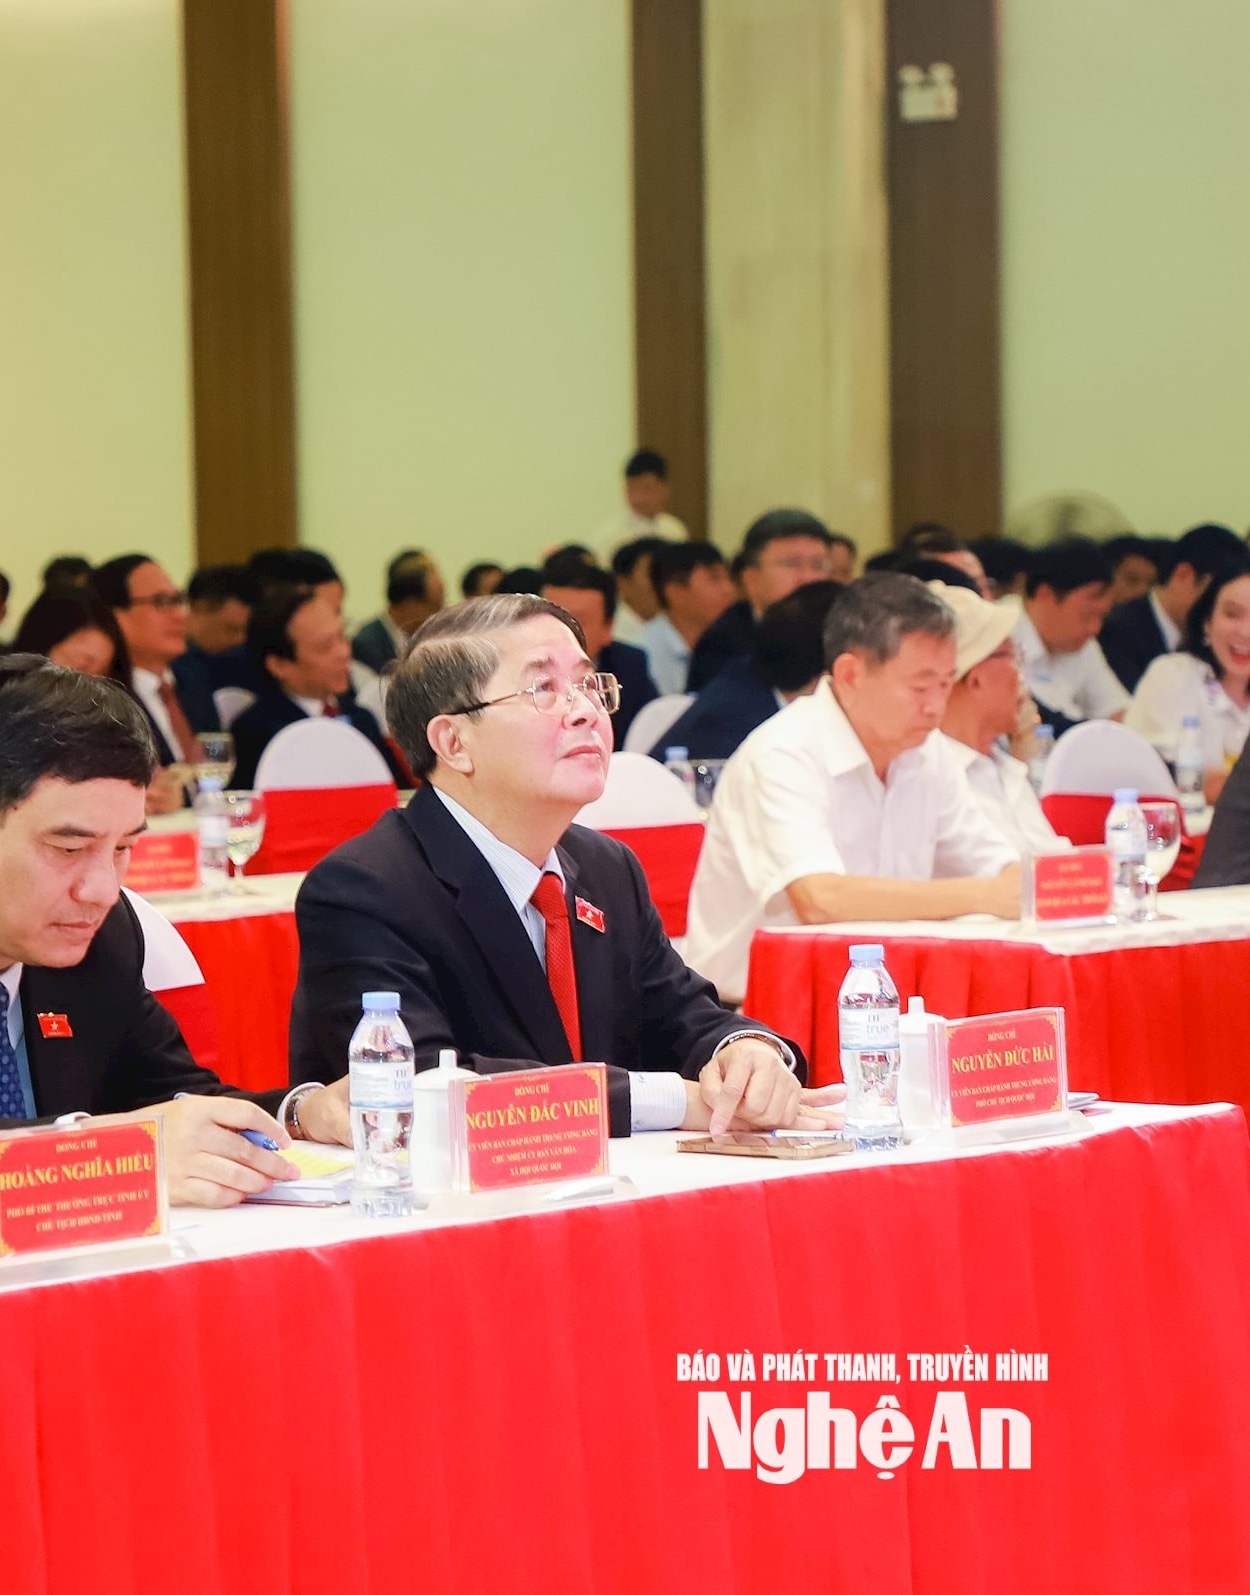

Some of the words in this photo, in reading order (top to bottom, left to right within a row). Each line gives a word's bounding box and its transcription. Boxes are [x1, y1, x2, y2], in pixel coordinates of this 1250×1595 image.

[1005, 1045, 1030, 1066] ĐỨC
[1032, 1041, 1054, 1063] HẢI
[564, 1098, 599, 1118] VINH
[0, 1166, 58, 1191] HOÀNG
[61, 1157, 113, 1182] NGHĨA
[115, 1152, 153, 1174] HIẾU
